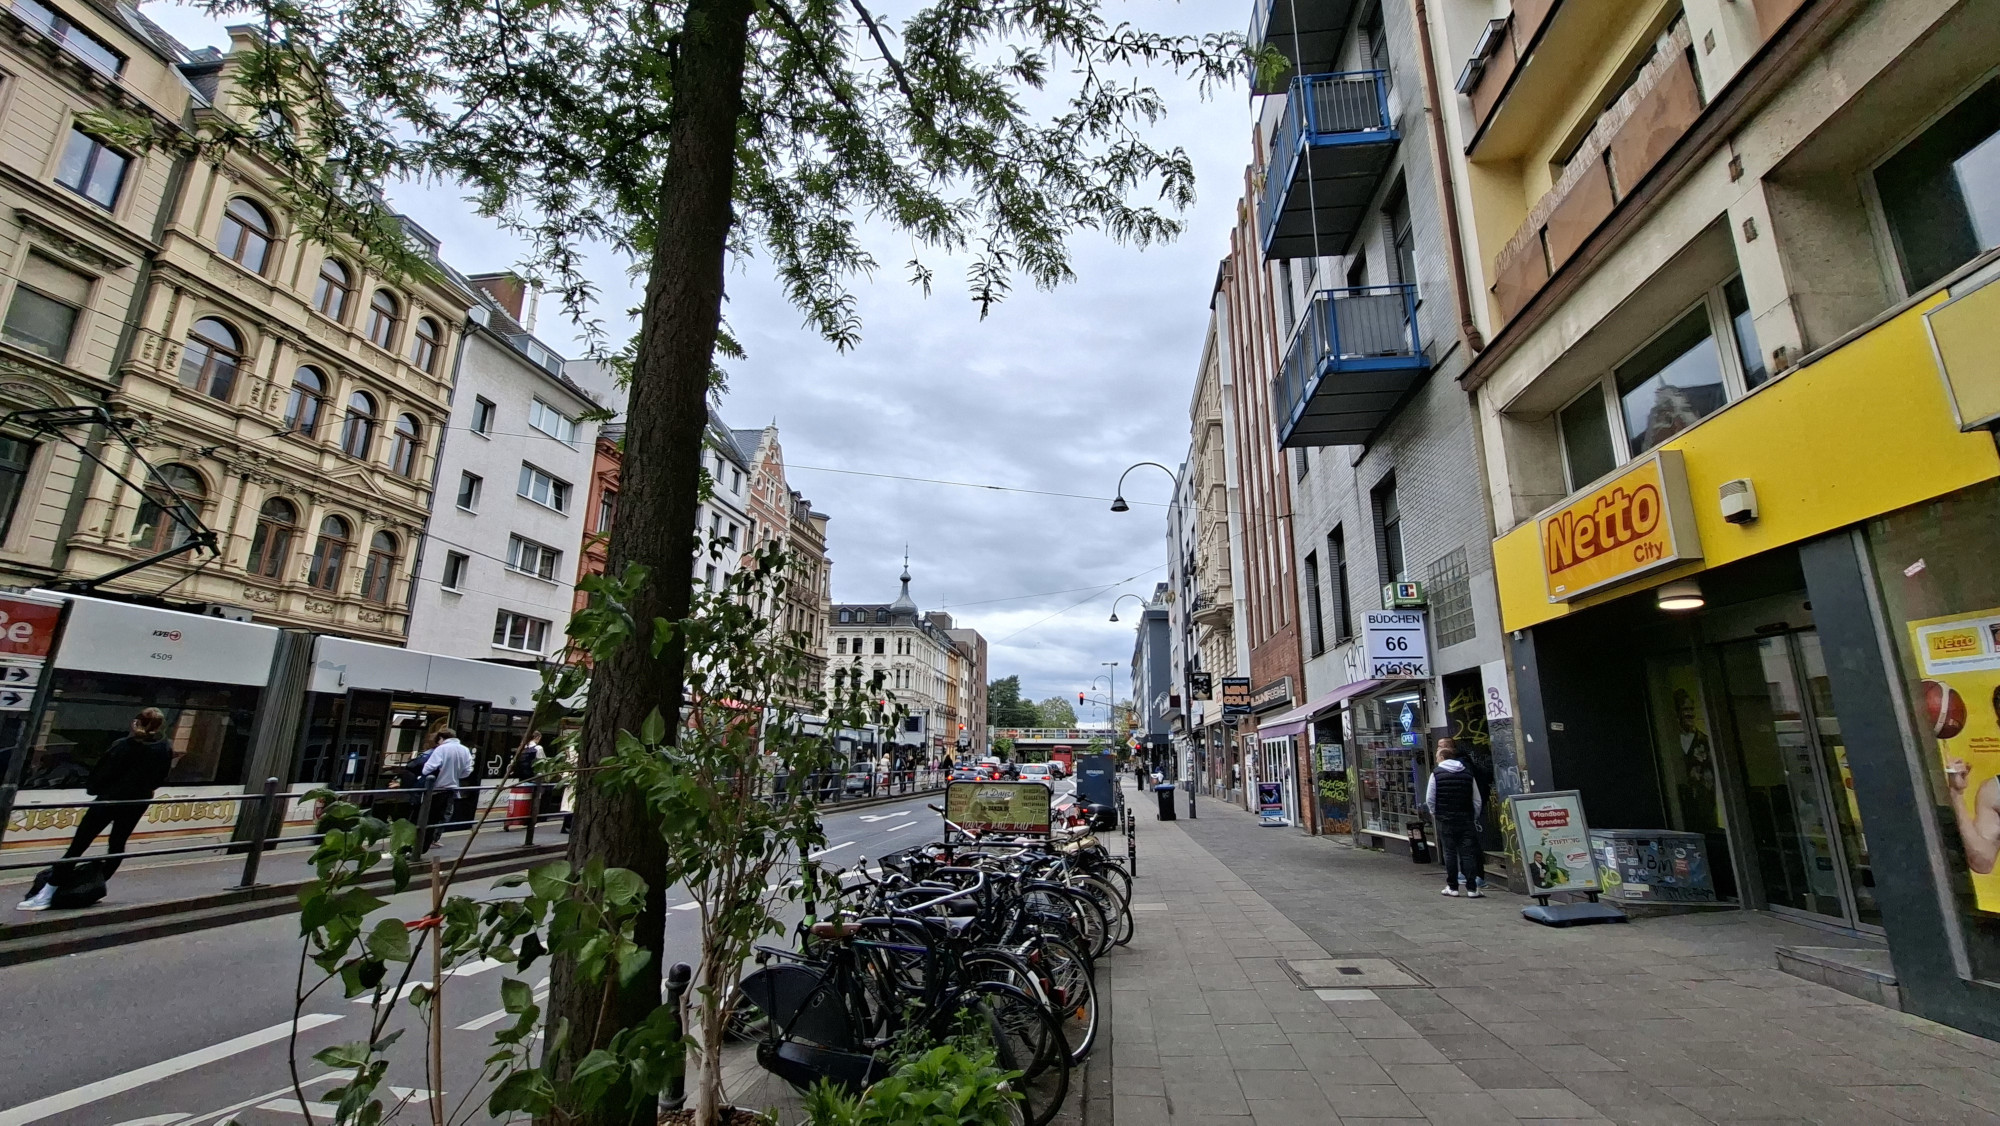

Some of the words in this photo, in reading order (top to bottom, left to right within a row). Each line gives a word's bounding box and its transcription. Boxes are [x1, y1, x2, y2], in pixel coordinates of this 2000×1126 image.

[1548, 484, 1660, 574] Netto
[1633, 541, 1663, 563] City
[1368, 613, 1420, 624] BÜDCHEN
[152, 629, 170, 638] KVB
[1385, 636, 1408, 651] 66
[1933, 634, 1976, 650] Netto
[150, 652, 173, 661] 4509
[1374, 663, 1424, 676] KIOSK
[1224, 685, 1248, 695] MINI
[1223, 696, 1250, 705] GOLF
[1537, 819, 1566, 827] spenden
